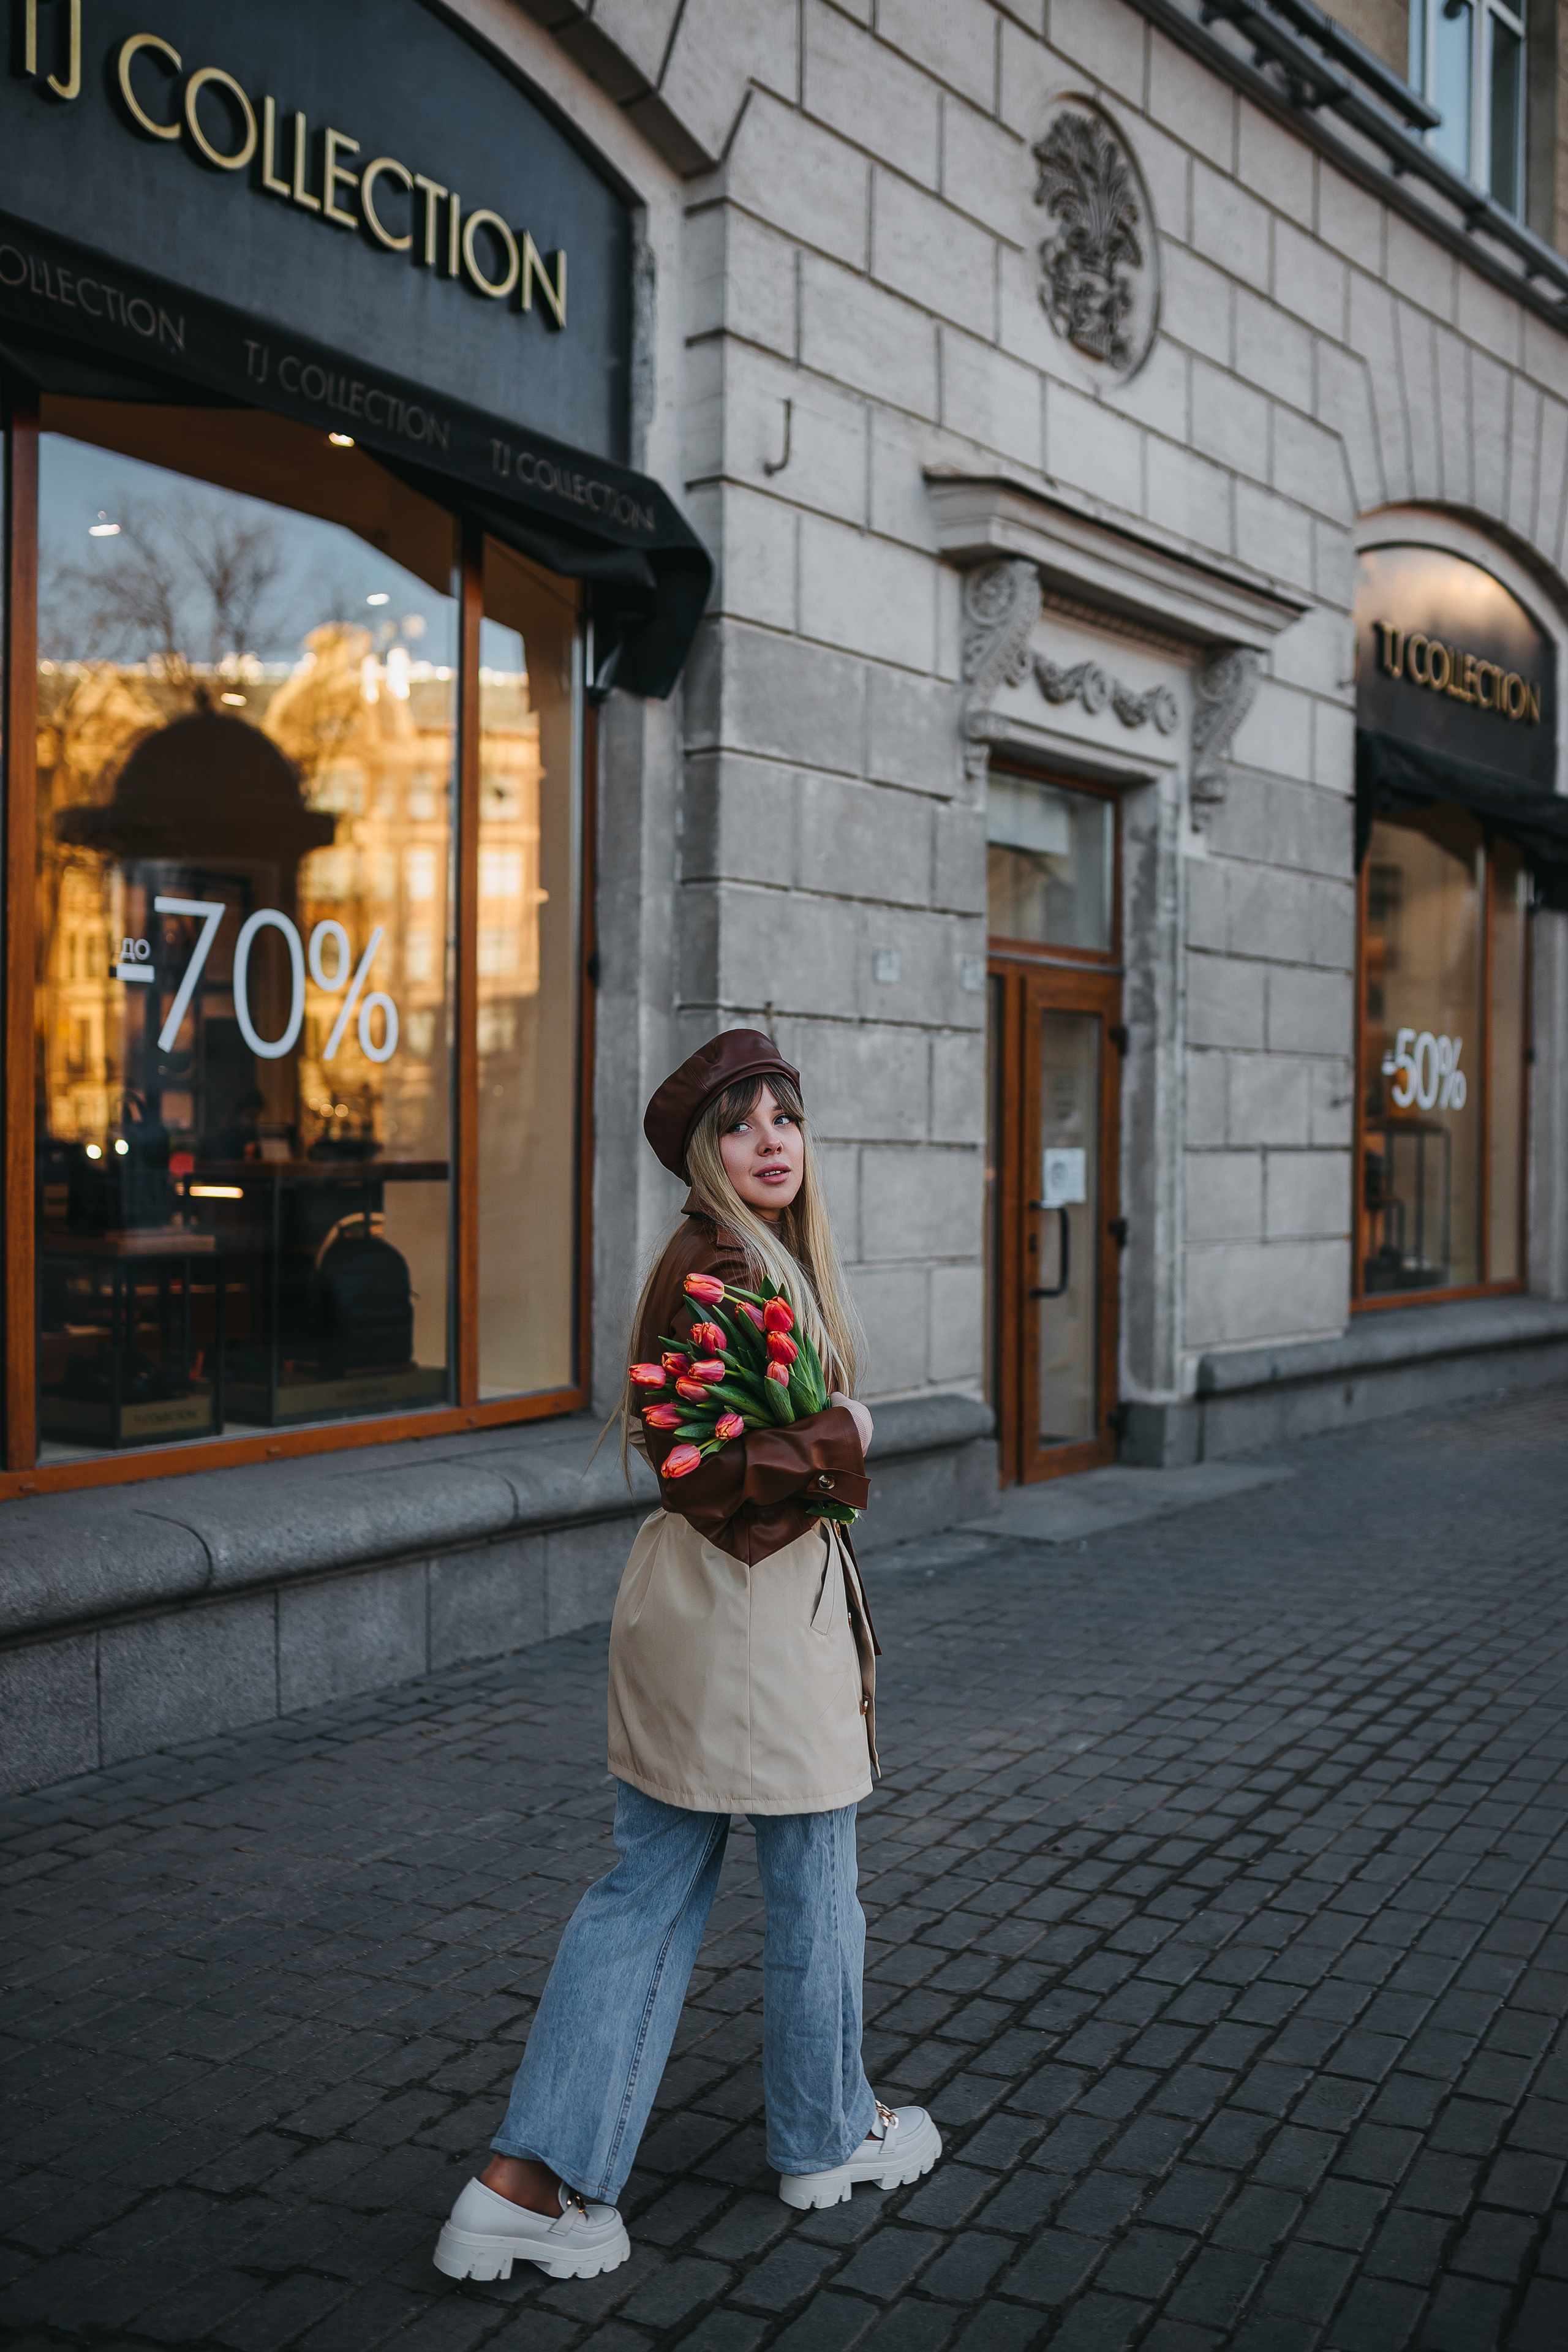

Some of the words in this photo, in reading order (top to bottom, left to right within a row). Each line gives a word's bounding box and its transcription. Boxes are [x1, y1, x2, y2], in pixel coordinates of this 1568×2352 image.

[118, 33, 567, 330] COLLECTION
[243, 338, 270, 384] TJ
[278, 356, 451, 451] COLLECTION
[490, 437, 511, 477] TJ
[516, 451, 656, 532] COLLECTION
[1373, 619, 1404, 679] TJ
[1409, 632, 1541, 725] COLLECTION
[116, 896, 399, 1063] -70%
[1381, 1027, 1467, 1110] -50%
